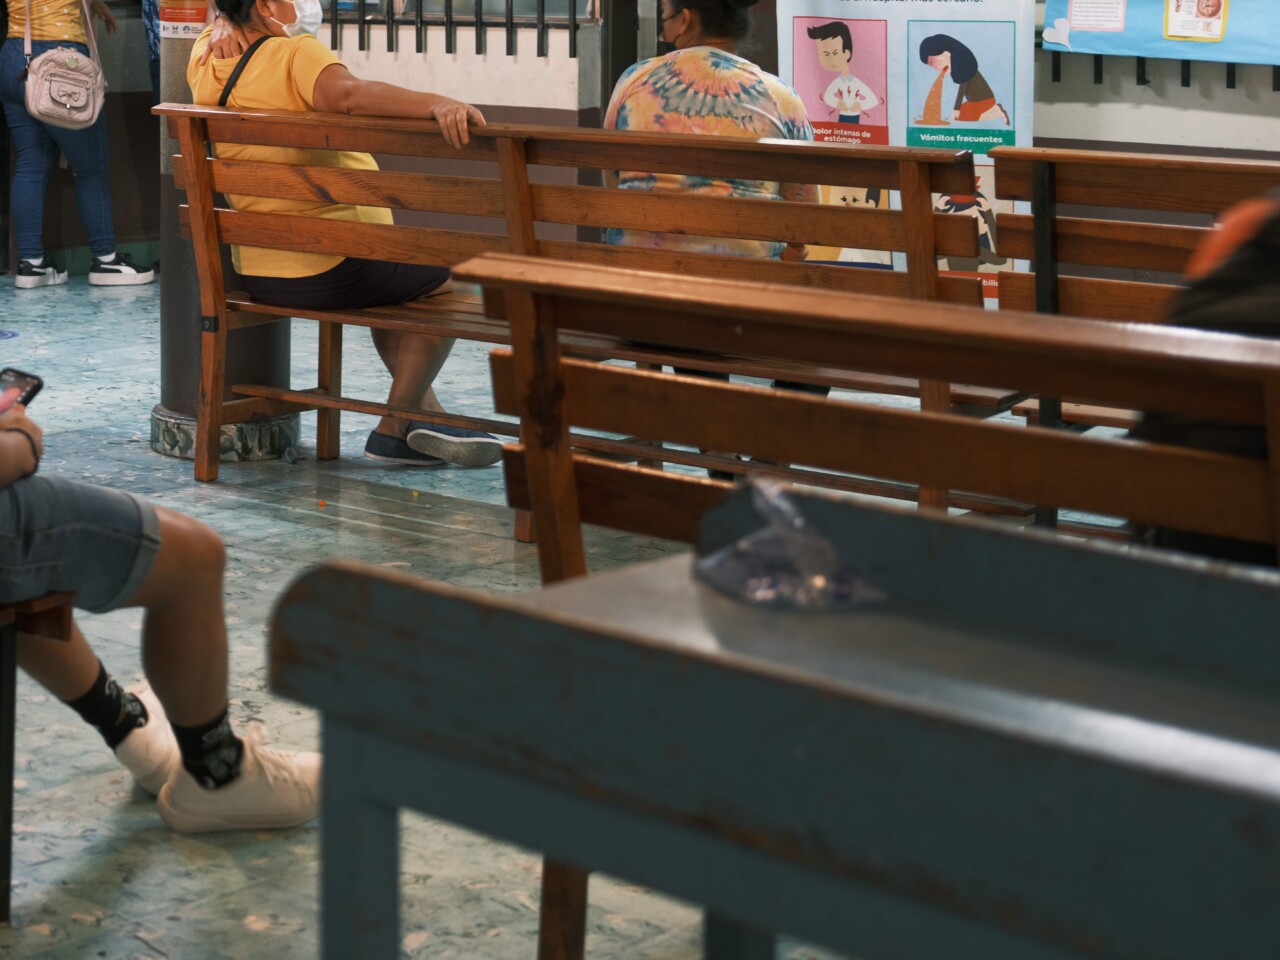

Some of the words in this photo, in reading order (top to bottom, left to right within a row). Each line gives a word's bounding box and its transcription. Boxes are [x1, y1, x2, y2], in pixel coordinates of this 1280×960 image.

[833, 128, 861, 137] intenso
[862, 130, 871, 138] de
[920, 133, 955, 142] Vómitos
[957, 134, 1003, 143] frecuentes
[824, 134, 862, 144] estómago
